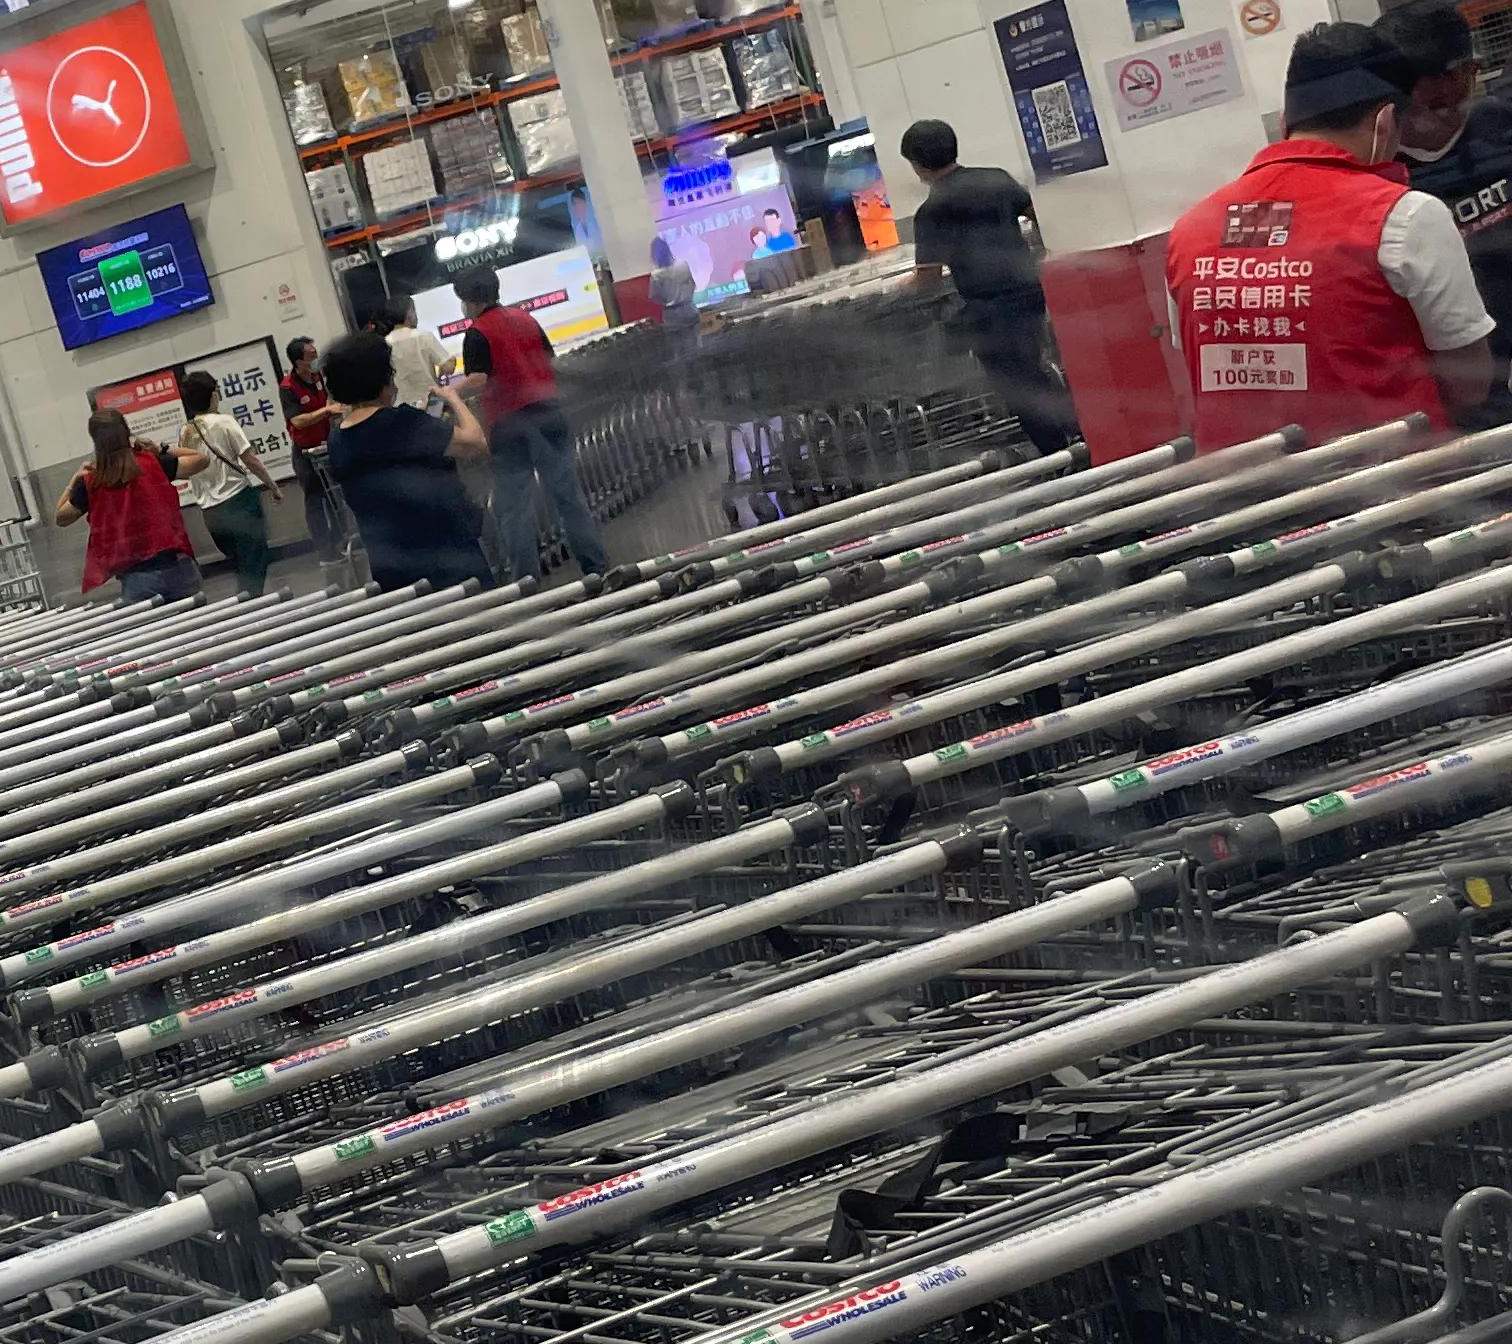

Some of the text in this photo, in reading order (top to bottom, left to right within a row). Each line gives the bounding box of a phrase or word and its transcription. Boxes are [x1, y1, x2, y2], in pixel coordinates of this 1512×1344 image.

[435, 216, 520, 261] SONY
[146, 262, 176, 281] 10216
[445, 251, 493, 274] BRAVIA
[1192, 256, 1313, 281] 平安Costco
[76, 287, 106, 304] 11404
[109, 273, 143, 295] 1188
[1192, 283, 1312, 312] 会员信用卡
[1213, 316, 1292, 338] 办卡找我
[217, 366, 267, 402] 出示
[1212, 369, 1295, 386] 100元奖励
[232, 398, 276, 429] 员卡
[538, 1170, 643, 1213] COSTCO
[574, 1180, 646, 1211] WHOLESALE
[917, 1264, 969, 1292] WARNING
[780, 1280, 902, 1330] COSTCO
[826, 1289, 909, 1327] WHOLESALE
